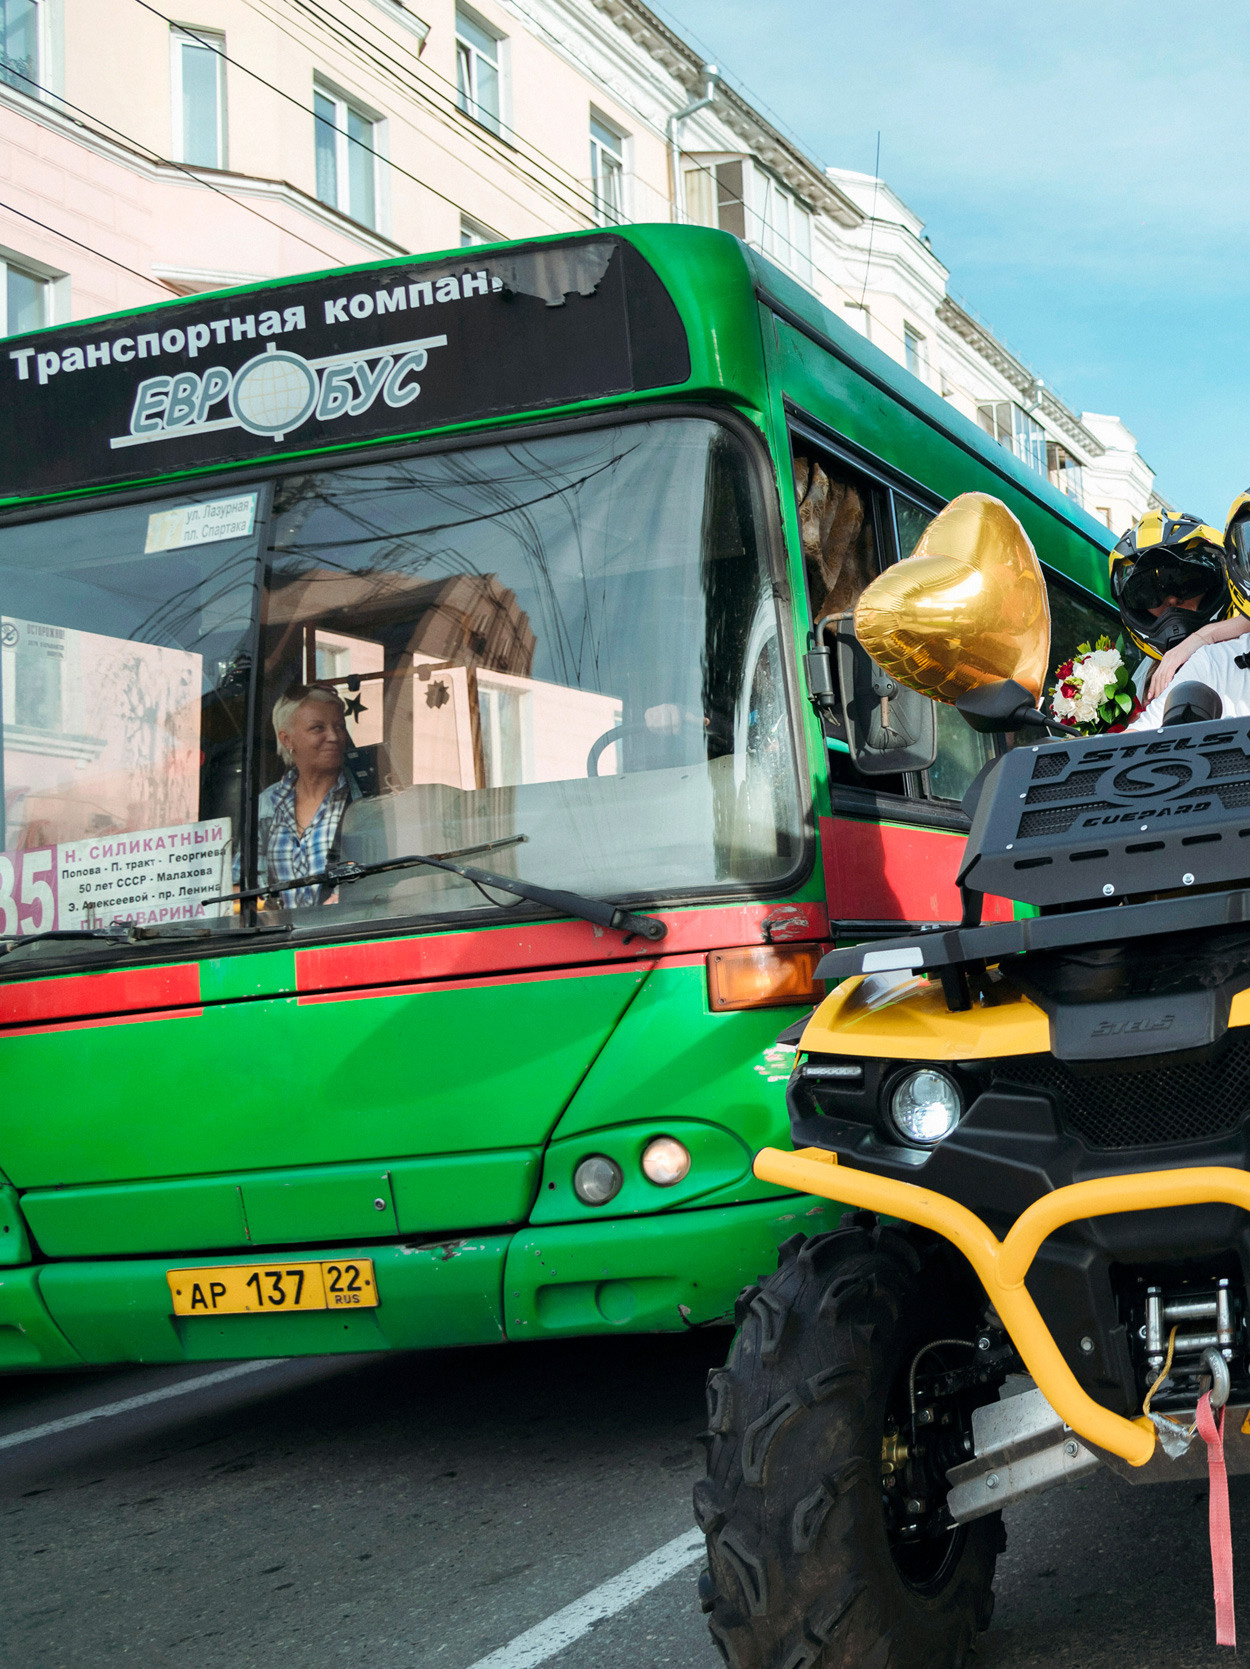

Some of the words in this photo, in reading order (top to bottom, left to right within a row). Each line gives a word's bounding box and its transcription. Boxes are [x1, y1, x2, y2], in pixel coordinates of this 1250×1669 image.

[9, 305, 308, 385] Транспортная
[202, 500, 250, 521] Лазурная
[201, 519, 247, 539] Спартака
[1078, 730, 1239, 765] STELS
[1082, 801, 1212, 828] GUEPARD
[65, 849, 82, 864] Н.
[89, 824, 223, 860] СИЛИКАТНЫЙ
[62, 867, 101, 879] Попова
[125, 858, 155, 871] тракт
[168, 848, 226, 863] Георгиева
[79, 883, 92, 894] 50
[95, 882, 113, 892] лет
[116, 875, 147, 888] СССР
[156, 867, 213, 882] Малахова
[82, 892, 149, 911] Алексеевой
[158, 891, 175, 900] пр.
[178, 883, 221, 897] Ленина
[246, 1270, 304, 1306] 137
[327, 1265, 363, 1292] 22
[334, 1294, 361, 1304] RUS
